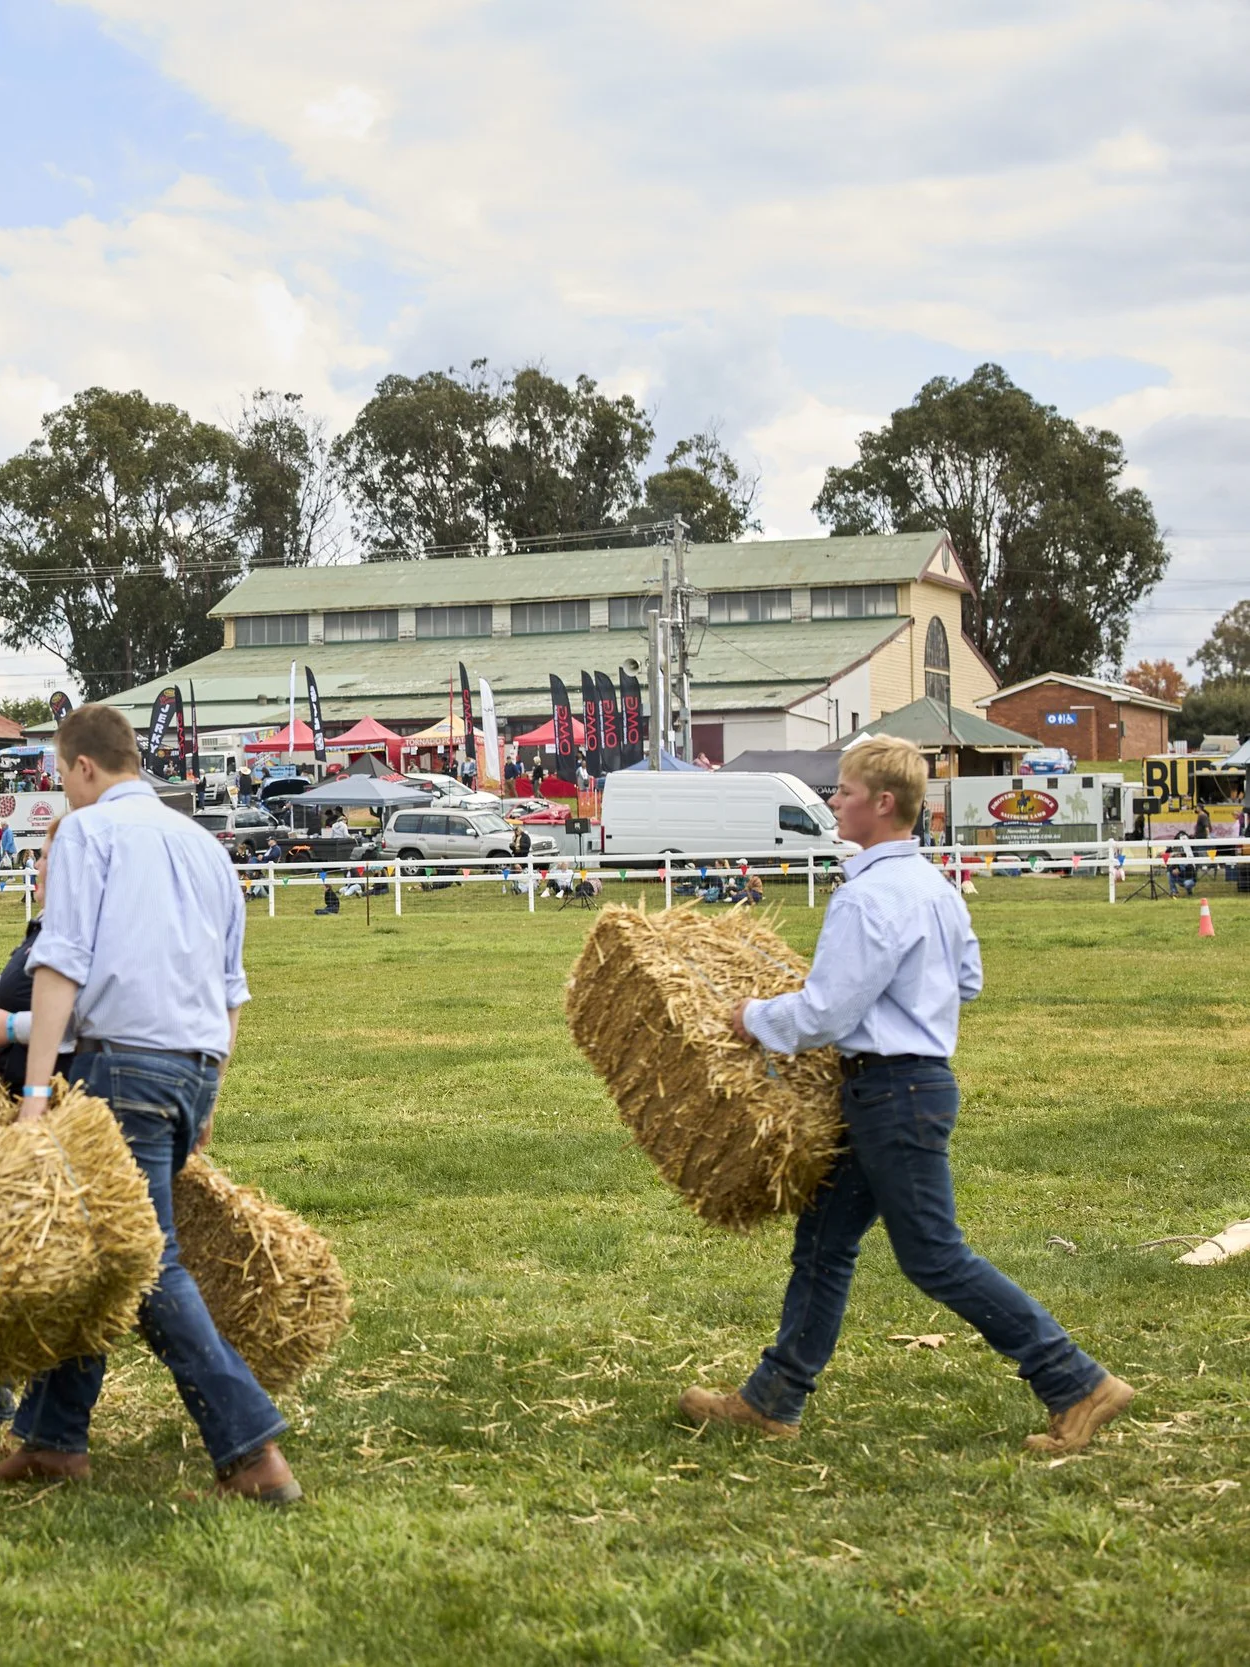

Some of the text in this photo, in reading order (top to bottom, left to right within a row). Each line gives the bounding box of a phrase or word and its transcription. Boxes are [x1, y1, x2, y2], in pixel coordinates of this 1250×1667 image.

[150, 703, 171, 754] JERKY
[442, 737, 466, 745] POTAT
[990, 793, 1055, 811] DROVERS CHOICE
[1000, 811, 1046, 820] SALTBUSH LAMB
